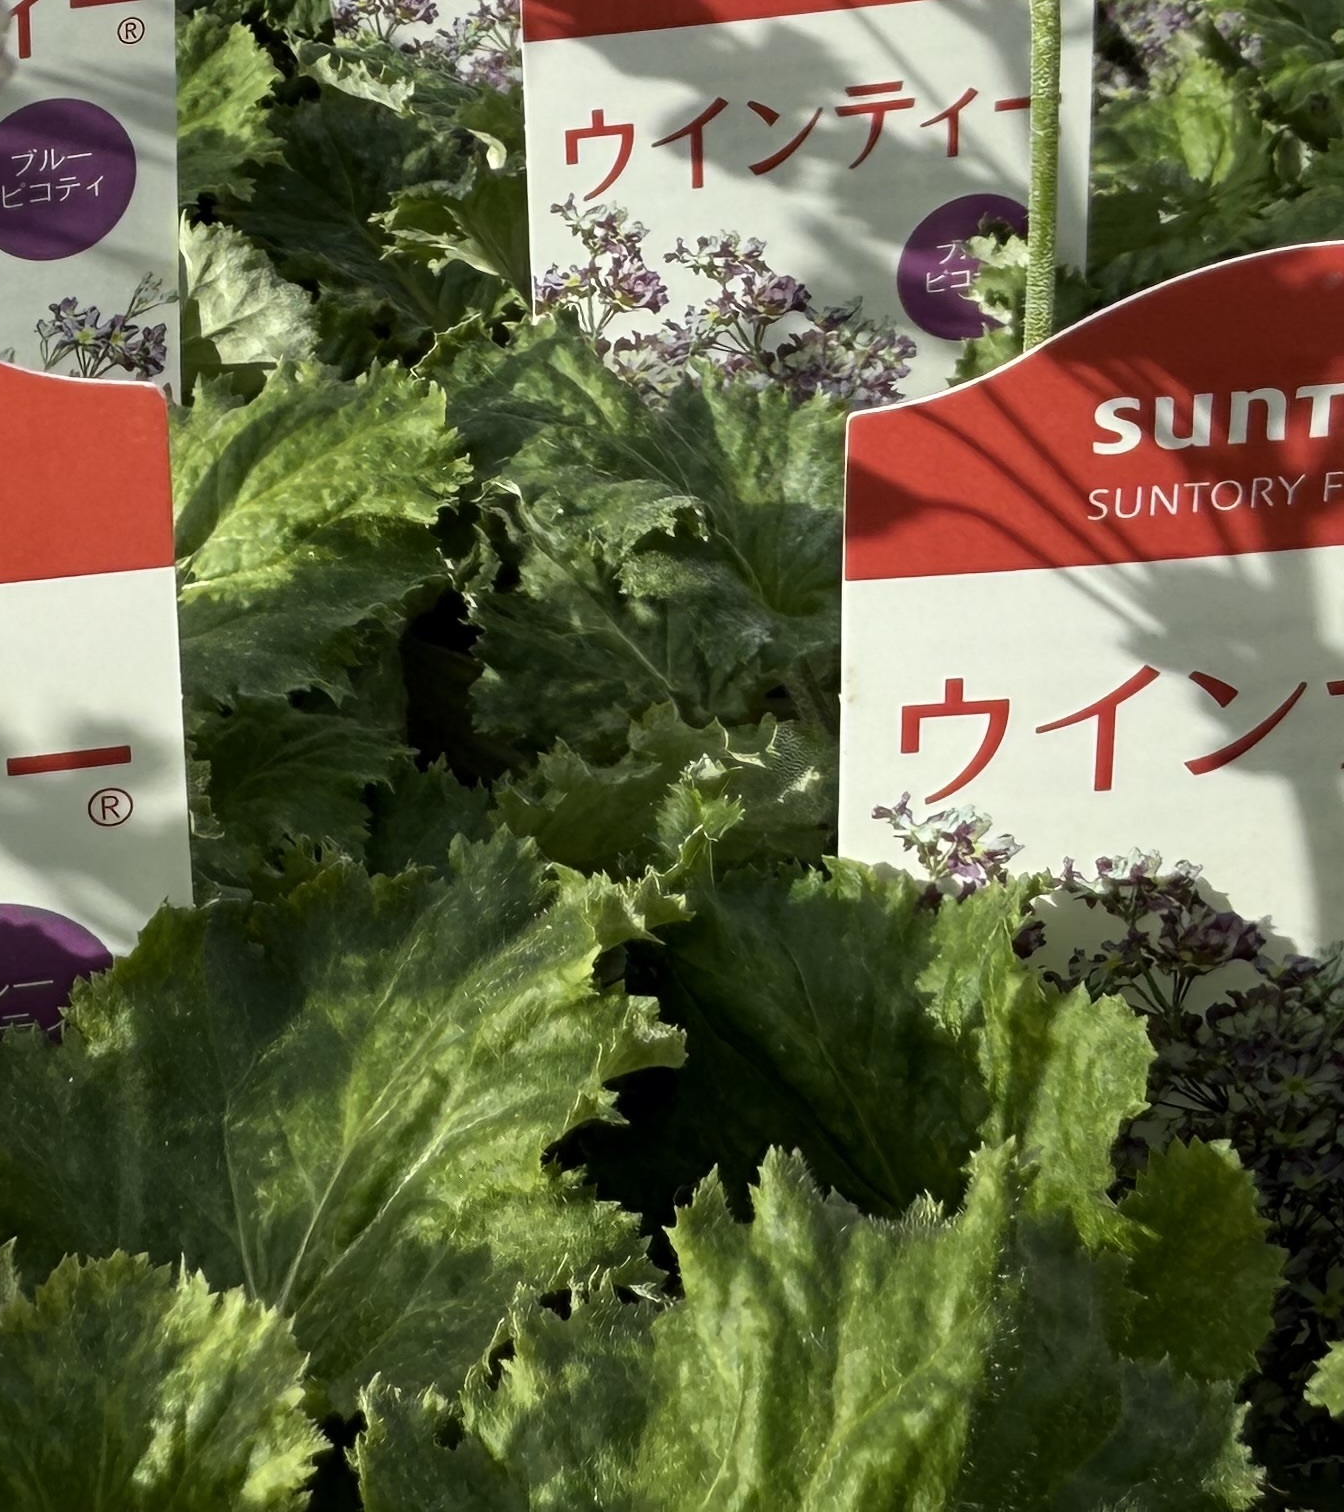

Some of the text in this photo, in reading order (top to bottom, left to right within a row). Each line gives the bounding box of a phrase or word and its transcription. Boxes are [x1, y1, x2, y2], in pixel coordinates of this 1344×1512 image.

[11, 148, 93, 172] ブルー
[1, 174, 104, 210] ピコティ
[1087, 472, 1306, 522] SUNTORY
